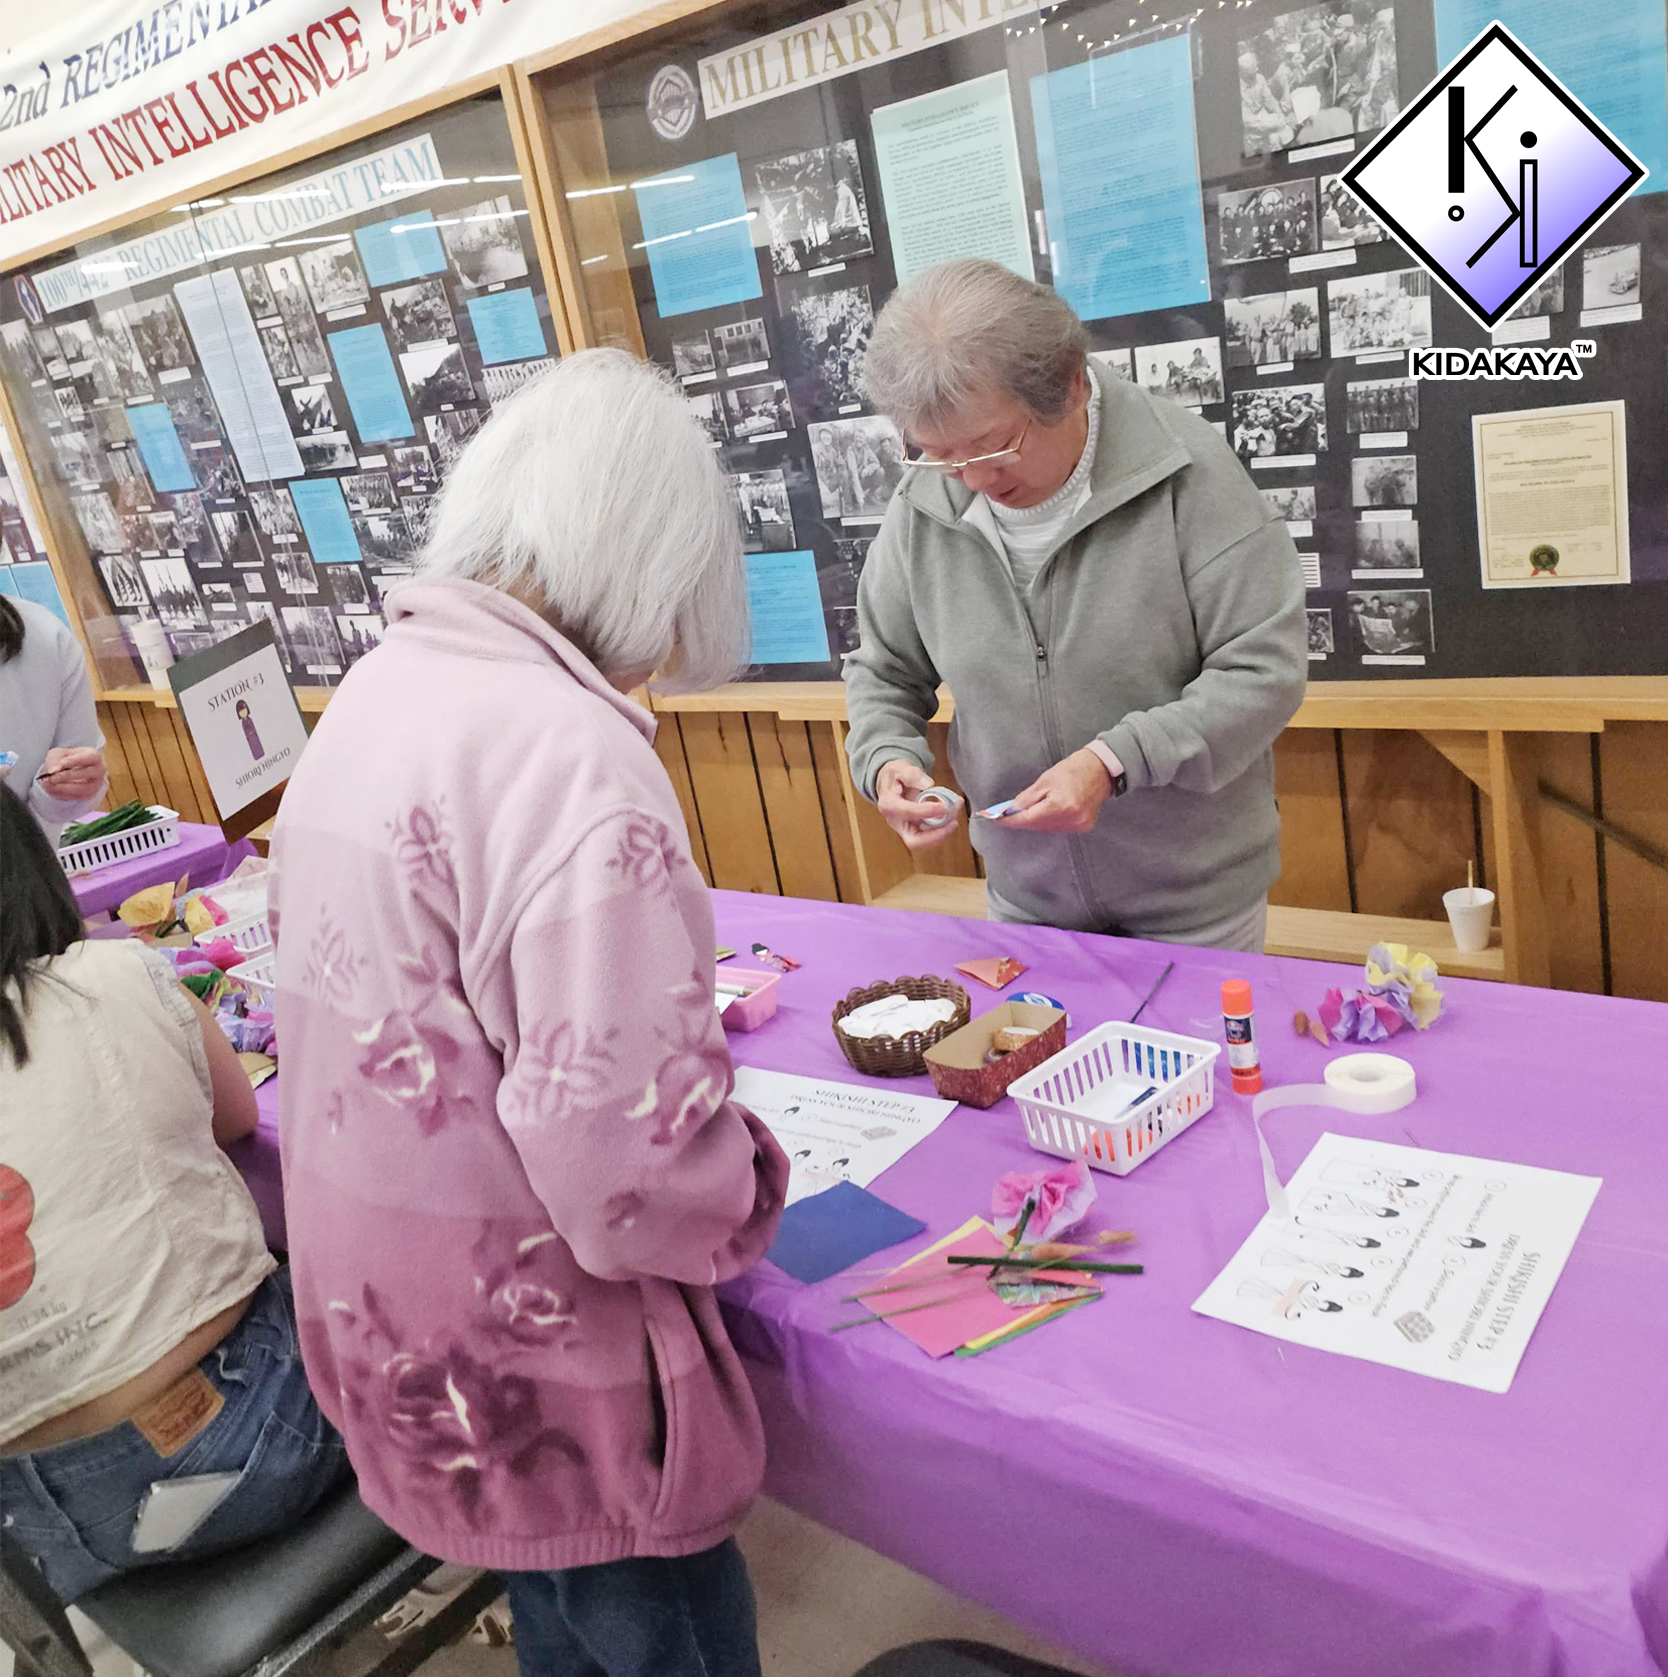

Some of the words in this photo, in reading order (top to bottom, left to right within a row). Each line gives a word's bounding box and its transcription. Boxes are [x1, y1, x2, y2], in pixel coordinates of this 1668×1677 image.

[88, 6, 369, 181] INTELLIGENCE
[703, 0, 902, 111] MILITARY
[118, 208, 255, 282] REGIMENTAL
[252, 170, 355, 237] COMBAT
[352, 141, 439, 204] TEAM
[207, 678, 253, 713] STATION
[253, 673, 265, 688] #3
[235, 764, 262, 790] SHIORI
[260, 746, 292, 773] NINGYO
